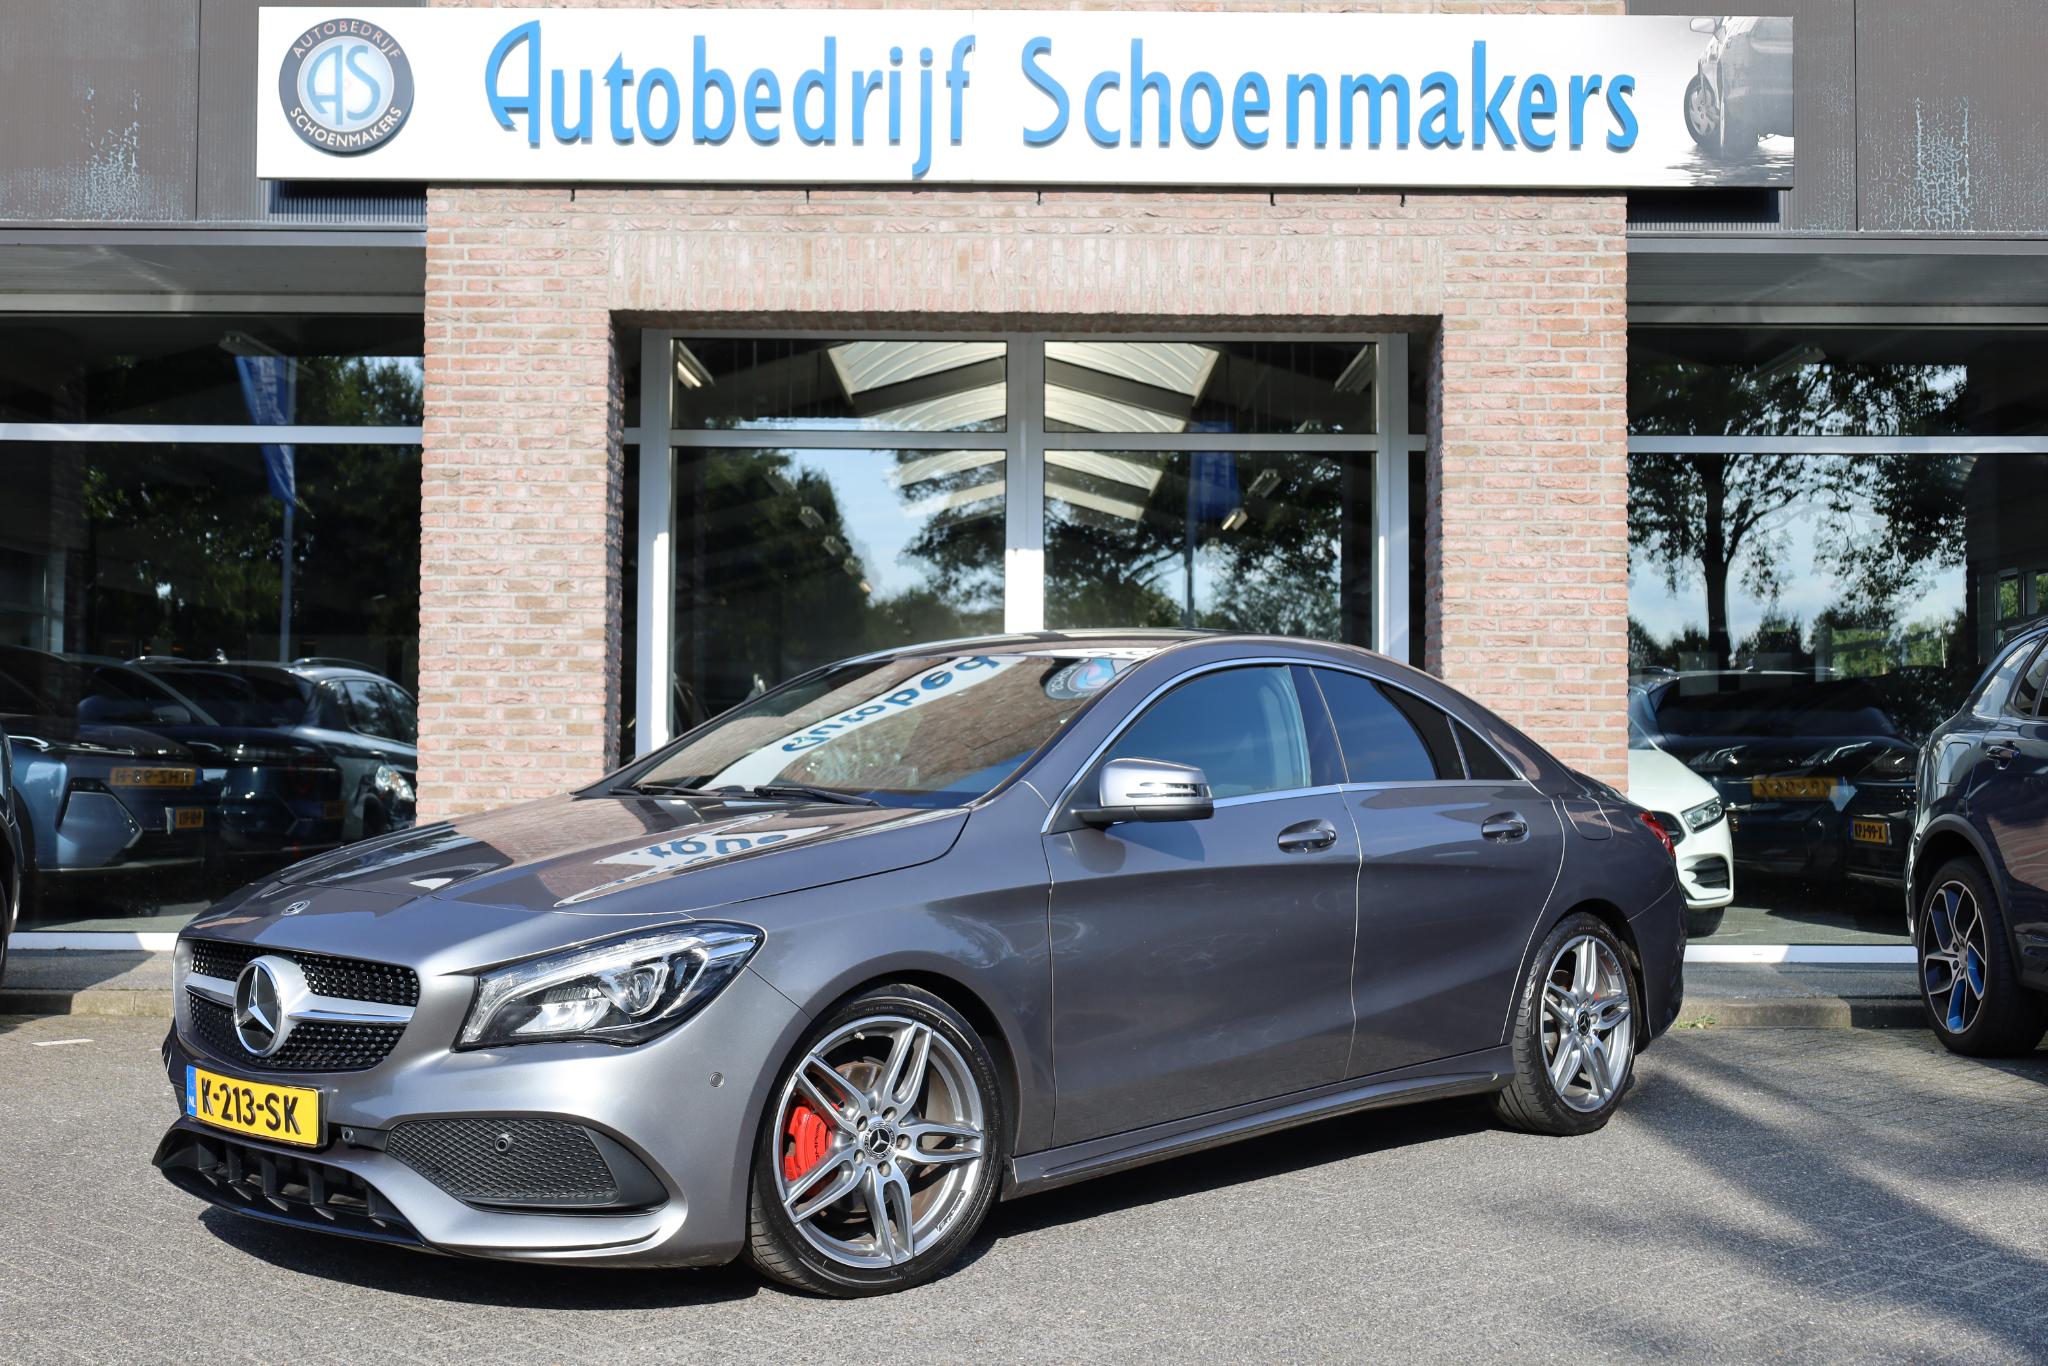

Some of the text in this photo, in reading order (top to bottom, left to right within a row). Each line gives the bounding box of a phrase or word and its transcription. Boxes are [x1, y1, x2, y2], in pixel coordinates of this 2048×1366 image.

[293, 20, 401, 58] AUTOBEDRIJF
[307, 45, 381, 125] AS
[485, 20, 1640, 181] Autobedrijf Schoenmakers
[290, 106, 402, 147] SCHOENMAKERS
[201, 1077, 302, 1135] K-213-SK
